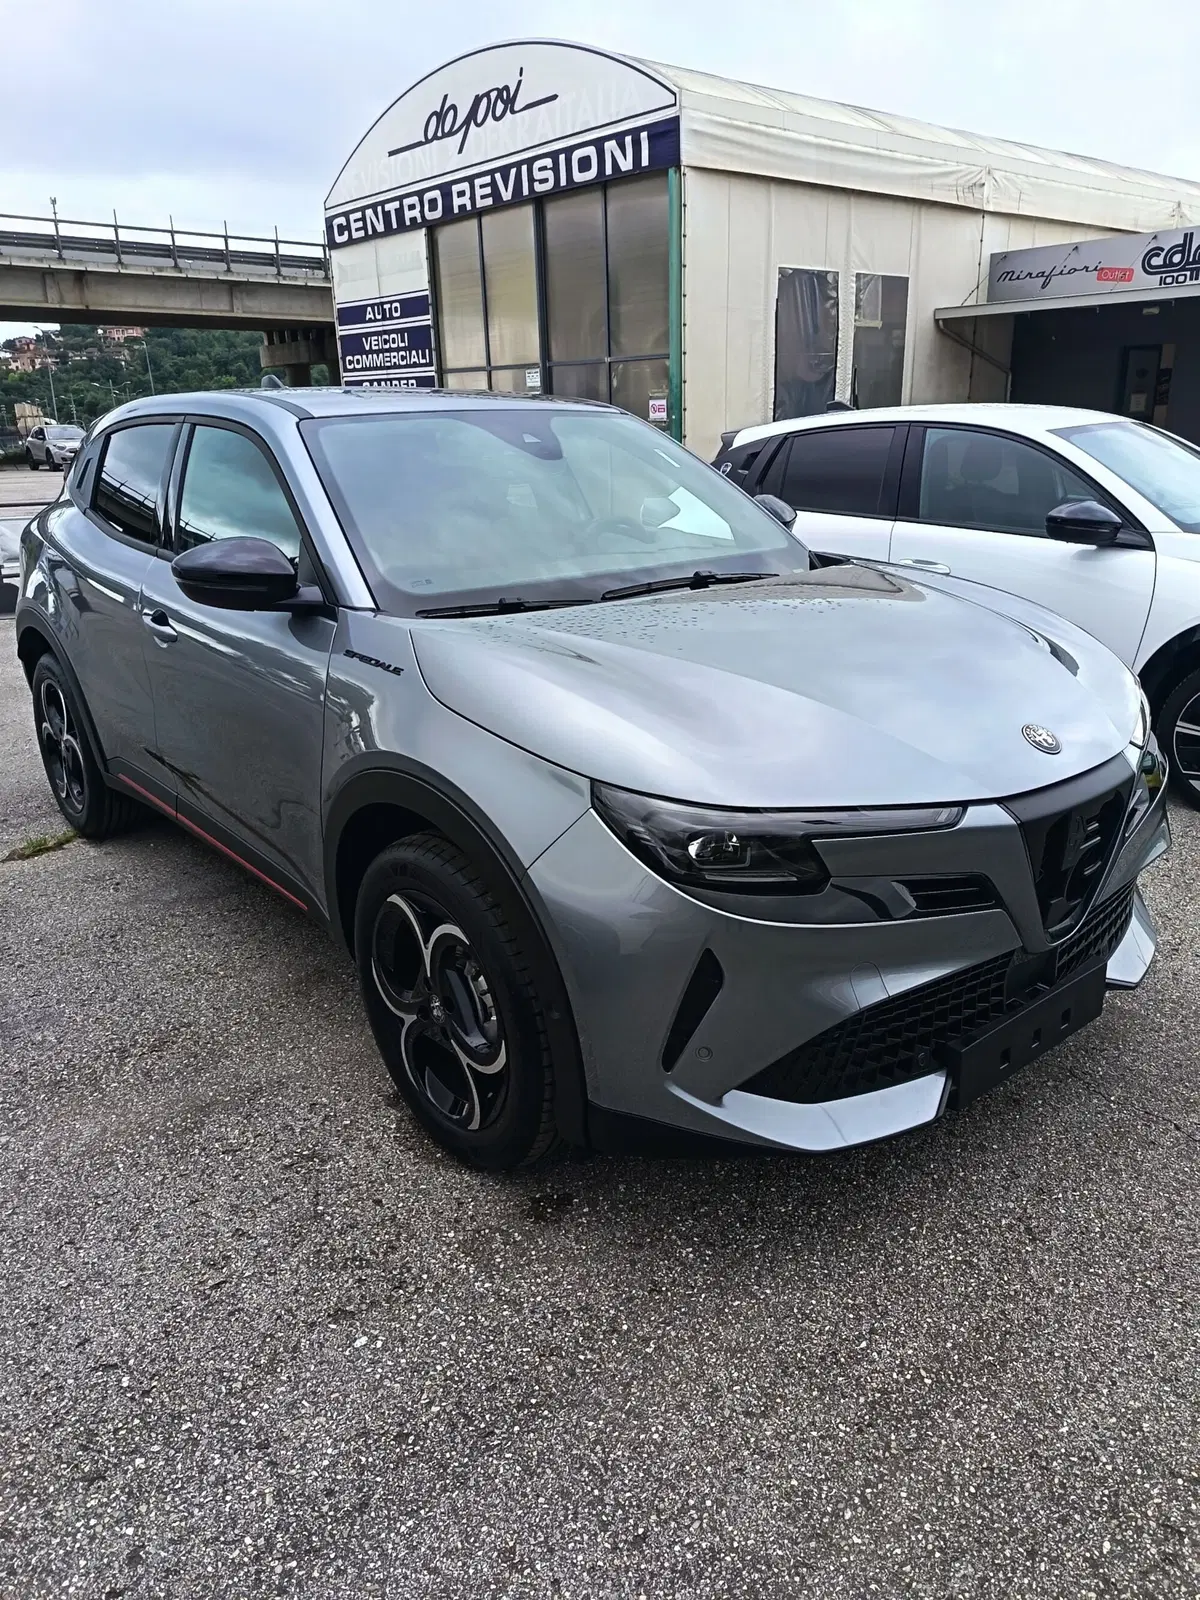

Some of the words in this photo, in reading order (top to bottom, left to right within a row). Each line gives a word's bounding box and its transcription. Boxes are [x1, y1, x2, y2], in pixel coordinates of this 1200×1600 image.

[332, 190, 443, 244] CENTRO
[451, 131, 649, 214] REVISIONI
[1101, 269, 1130, 281] Outlet
[365, 302, 401, 321] AUTO
[362, 332, 409, 351] VEICOLI
[345, 348, 430, 370] COMMERCIALI
